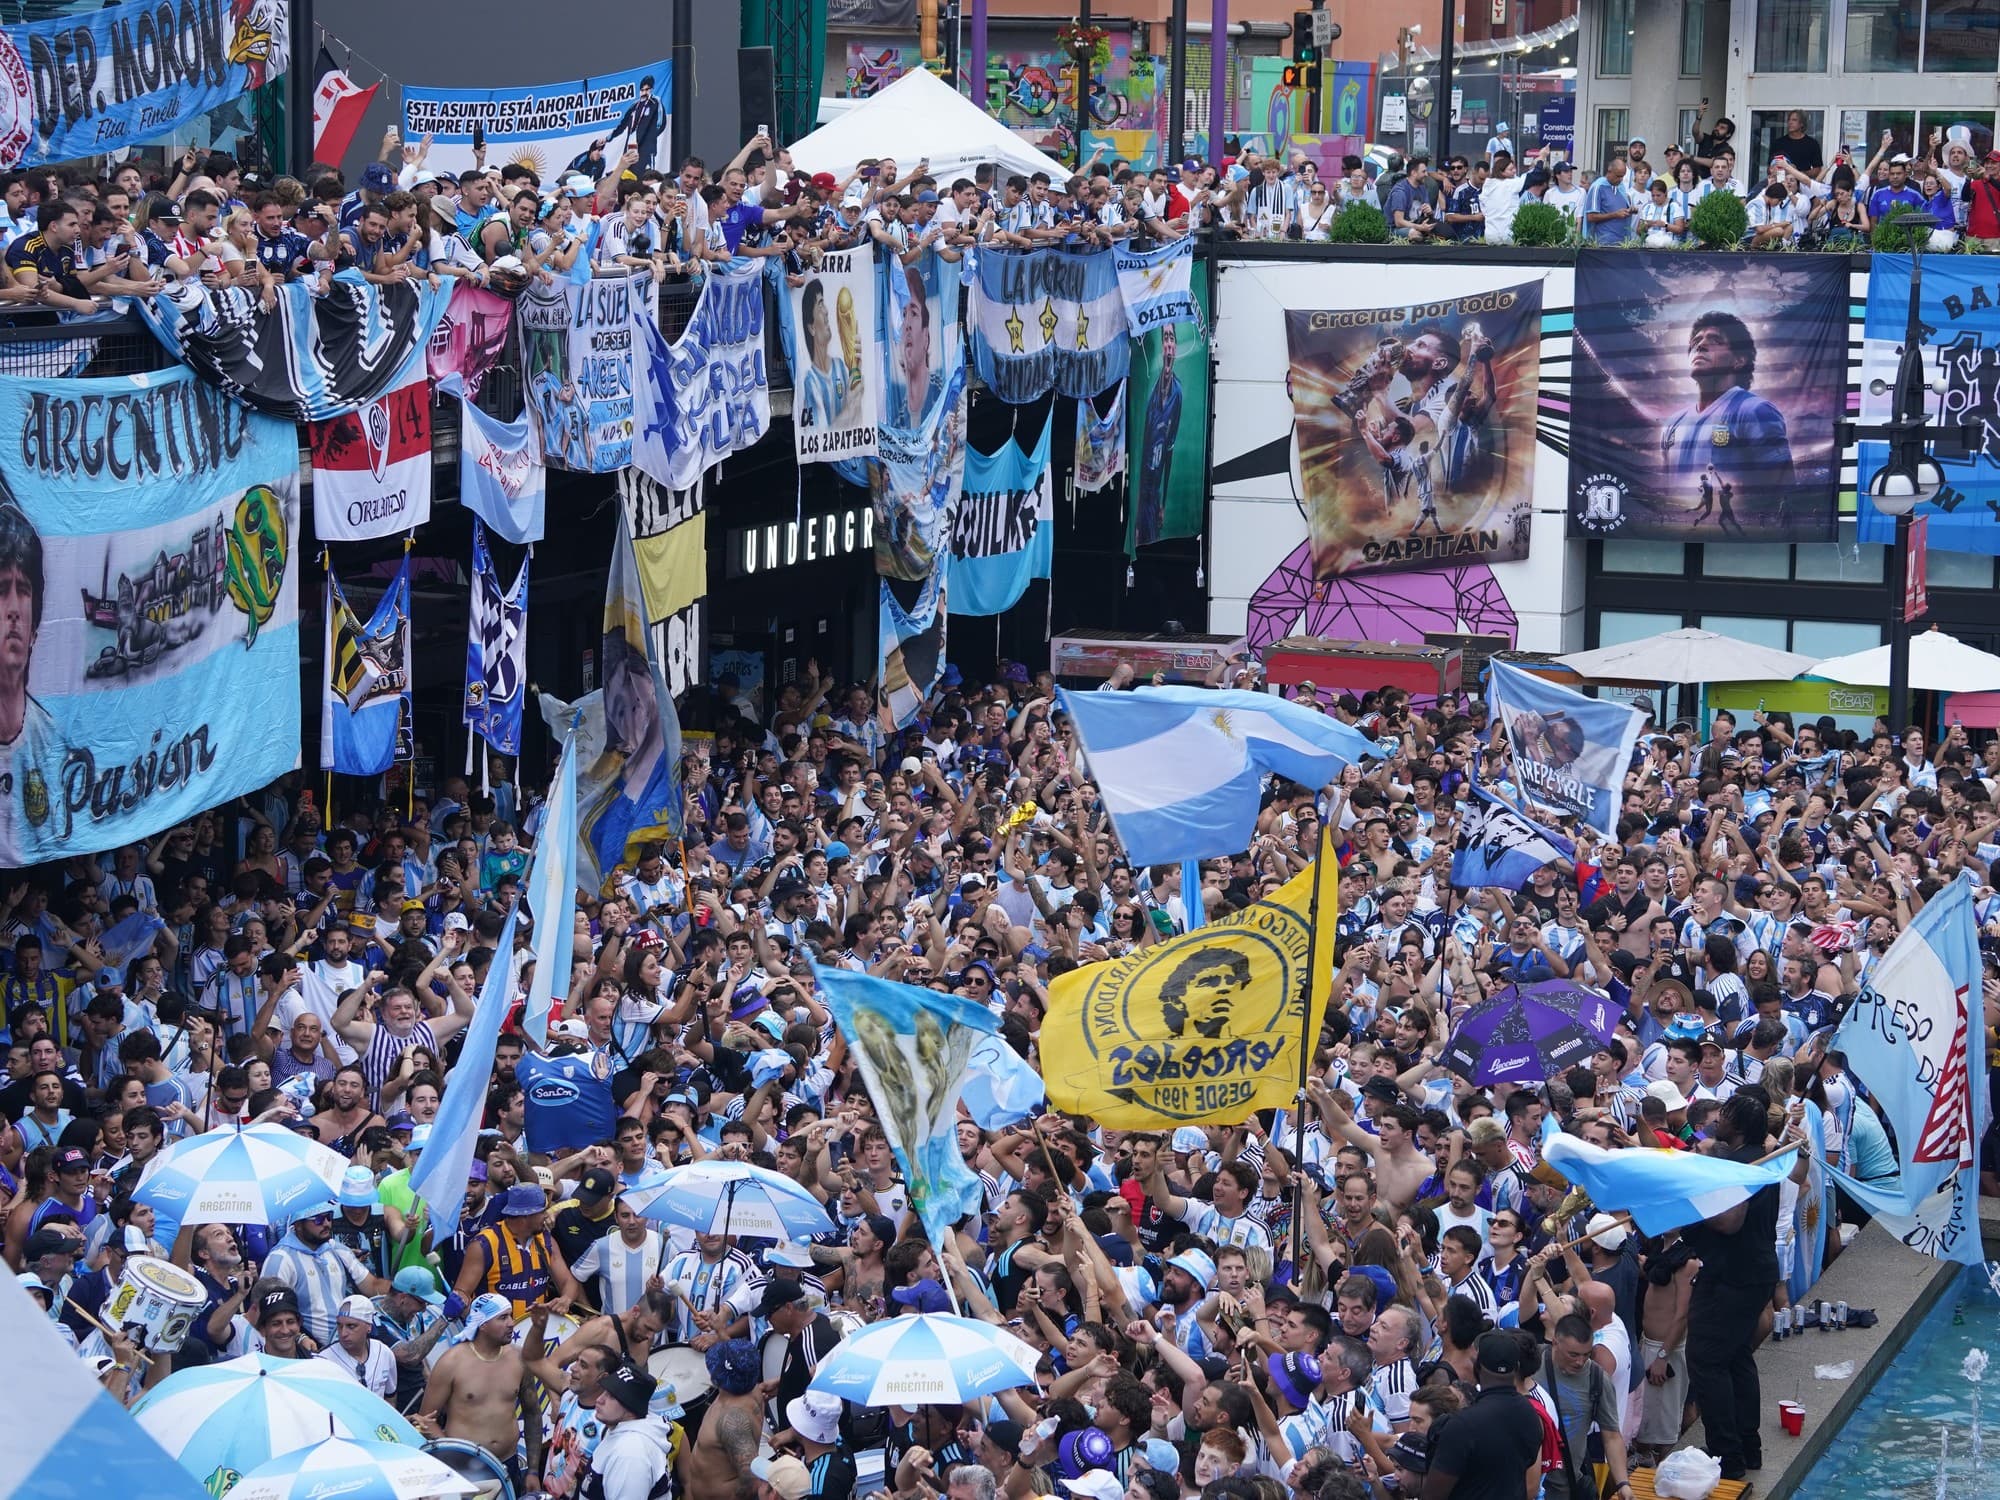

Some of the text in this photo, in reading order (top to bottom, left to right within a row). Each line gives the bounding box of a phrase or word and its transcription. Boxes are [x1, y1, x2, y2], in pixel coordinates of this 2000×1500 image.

[1317, 14, 1326, 22] NO
[1316, 24, 1329, 33] RIGHT
[1316, 34, 1329, 42] TURN
[29, 26, 106, 139] DEP.
[407, 84, 635, 118] ESTE ASUNTO ESTÁ AHORA Y PARA
[407, 116, 461, 134] SIEMPRE
[464, 118, 484, 134] EN
[487, 117, 513, 134] TUS
[514, 112, 572, 133] MANOS,
[1543, 133, 1566, 141] Access
[817, 254, 852, 274] ARRA
[1309, 290, 1514, 330] Gracias por todo
[801, 433, 820, 455] LOS
[347, 489, 407, 527] ORLANDO
[745, 506, 873, 574] UNDERGR
[1362, 526, 1499, 563] CAPITÁN
[1186, 656, 1210, 668] BAR
[1845, 695, 1871, 708] BAR
[1857, 987, 1934, 1045] PRESO
[535, 1087, 573, 1098] SanCor
[200, 1200, 252, 1212] ARGENTINA
[499, 1281, 528, 1291] CABLE
[886, 1380, 944, 1393] ARGENTINA
